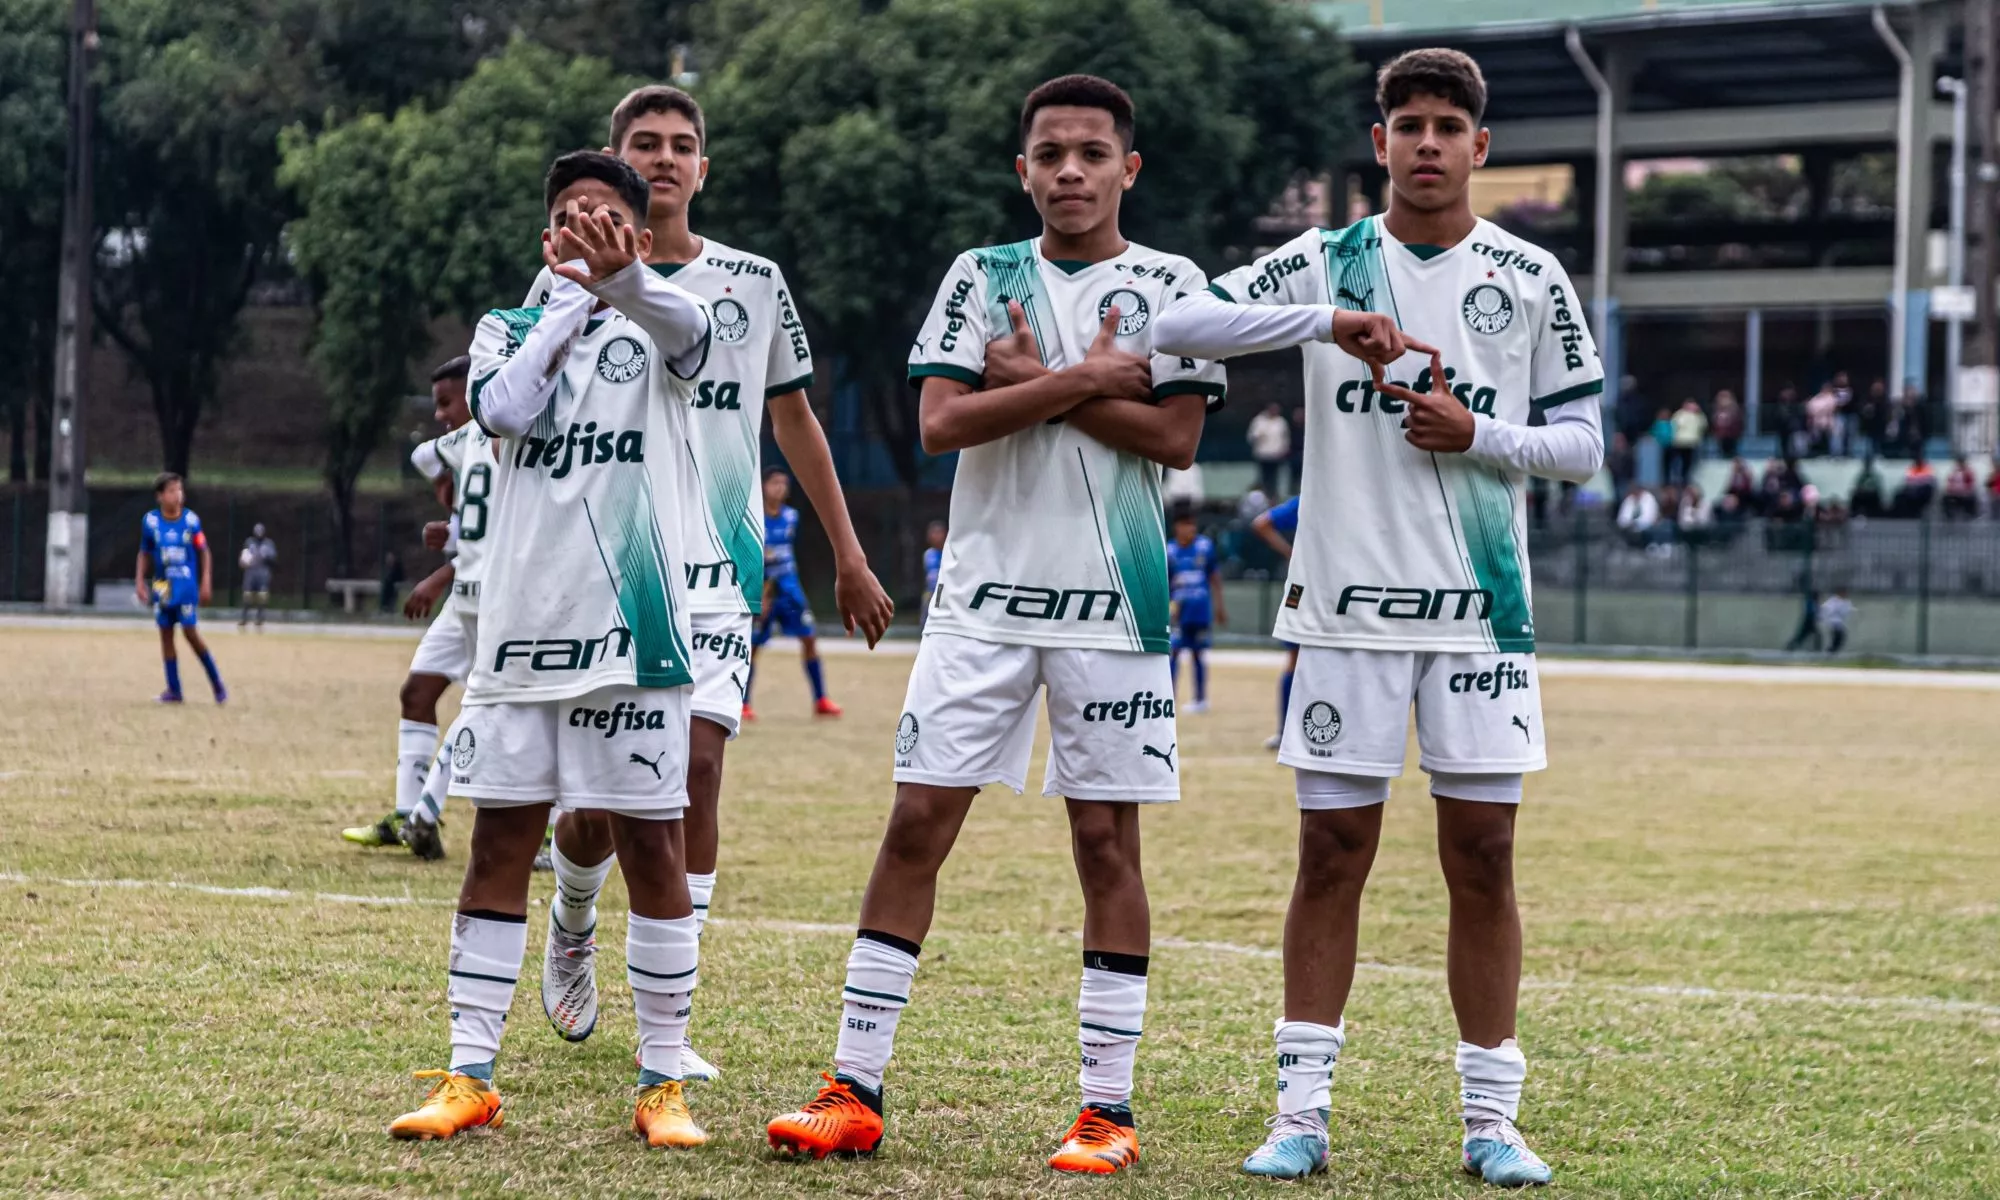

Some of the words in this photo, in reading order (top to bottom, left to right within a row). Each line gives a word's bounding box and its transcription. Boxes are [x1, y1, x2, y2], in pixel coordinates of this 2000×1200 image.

[706, 257, 772, 279] crefisa
[1248, 252, 1309, 299] cefisa
[1471, 241, 1543, 276] crefisa
[777, 289, 809, 362] crefisa
[940, 278, 974, 353] crefisa
[1464, 303, 1513, 334] PALMEIRAS
[1549, 283, 1584, 371] crefisa
[598, 353, 645, 382] PALMEIRAS
[459, 463, 492, 541] 8
[1450, 661, 1529, 699] crefisa
[568, 702, 666, 738] crefisa
[1083, 691, 1175, 729] crefisa
[847, 1017, 877, 1032] SEP
